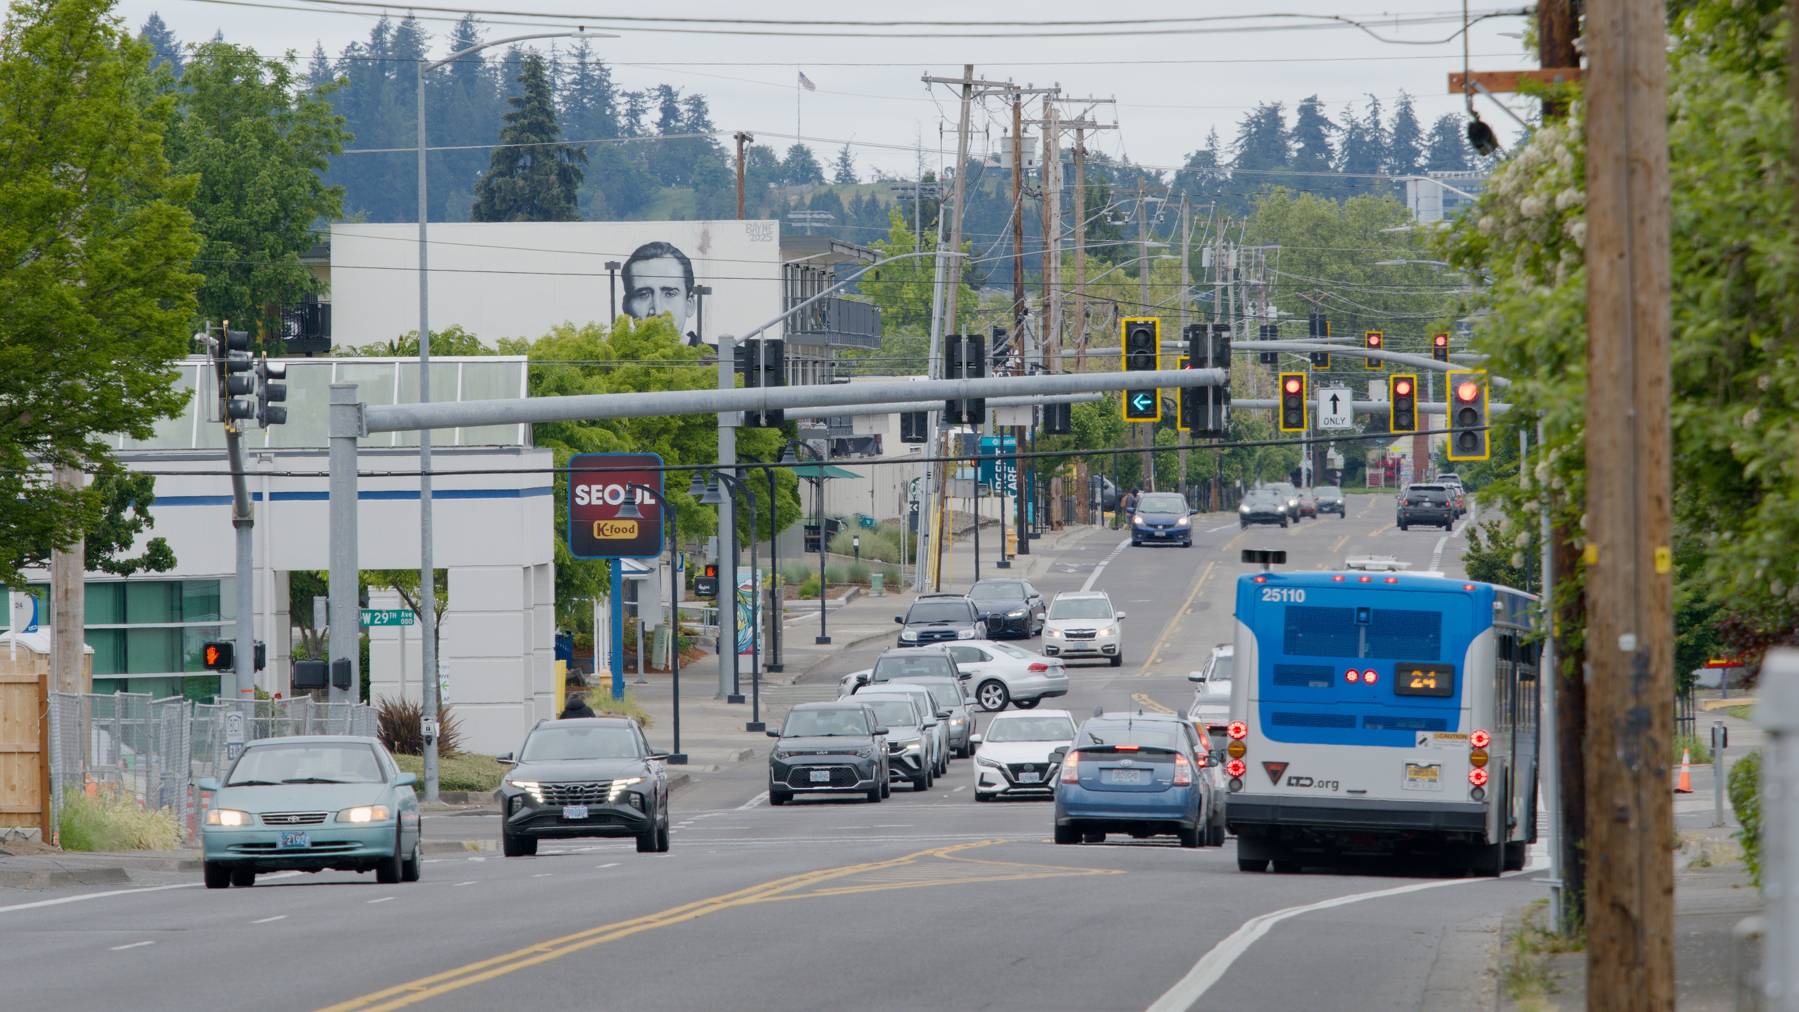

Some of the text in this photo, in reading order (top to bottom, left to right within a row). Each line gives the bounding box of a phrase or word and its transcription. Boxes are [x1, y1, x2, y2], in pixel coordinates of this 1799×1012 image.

[746, 222, 775, 234] BAYNE
[749, 233, 773, 242] 2025
[1323, 417, 1346, 426] ONLY
[597, 523, 635, 537] K-food
[1262, 588, 1305, 603] 25110
[362, 612, 372, 625] W
[374, 612, 397, 624] 29TH
[1410, 670, 1436, 689] 24
[1287, 776, 1339, 792] LTD.org
